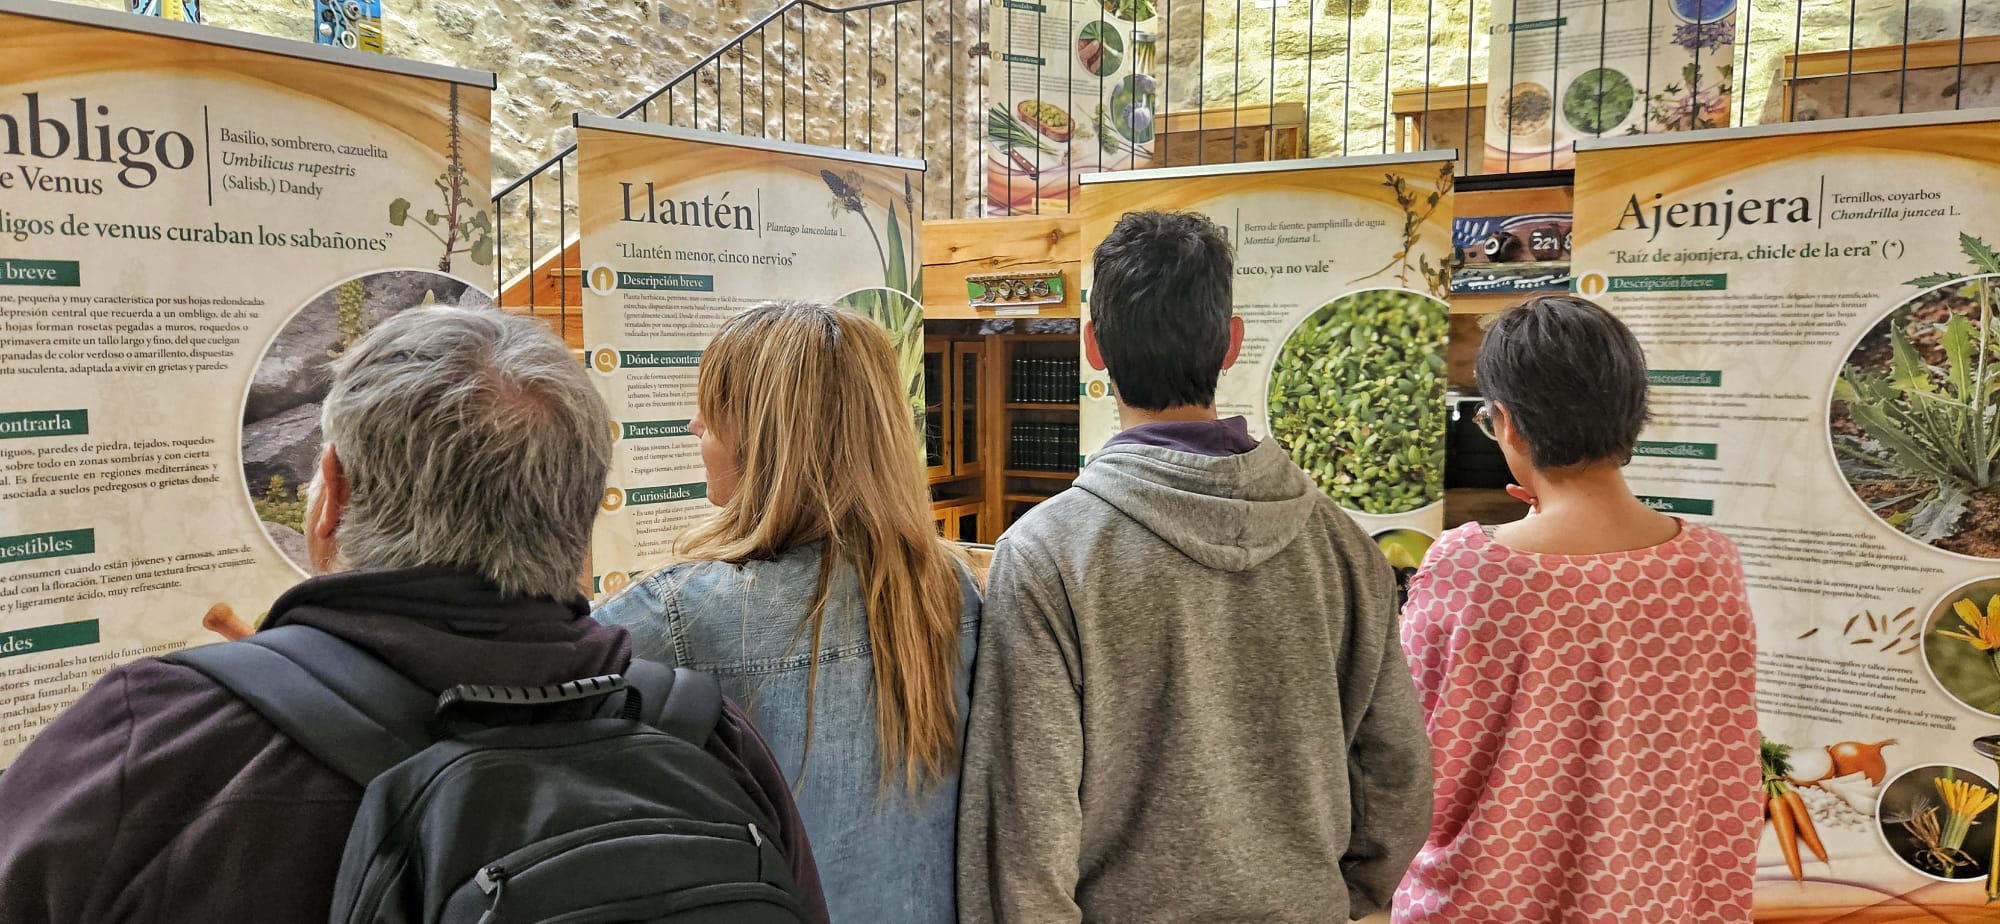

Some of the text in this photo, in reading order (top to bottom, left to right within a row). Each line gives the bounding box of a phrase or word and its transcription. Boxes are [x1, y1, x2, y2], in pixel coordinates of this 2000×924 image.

[221, 128, 389, 159] Basilio, sombrero, cazuelita
[222, 151, 357, 178] Umbilicus rupestris
[18, 165, 104, 196] Venus
[222, 174, 324, 200] (Salisb.) Dandy
[1832, 189, 1941, 205] Ternillos, coyarbos
[619, 182, 755, 232] Llantén
[1831, 205, 1961, 222] Chondrilla juncea L.
[1613, 189, 1813, 243] Ajenjera
[60, 213, 90, 237] de
[94, 222, 162, 241] venus
[167, 222, 254, 244] curaban
[258, 225, 287, 247] los
[290, 228, 393, 252] sabañones”
[766, 222, 800, 237] Plantago
[801, 224, 838, 238] lanceolata
[1244, 217, 1386, 233] Berro de fuente, pamplinilla de agua
[1244, 236, 1275, 246] Montia
[1275, 235, 1311, 247] fontana
[616, 243, 797, 267] “Llantén menor, cinco nervios”
[1609, 249, 1649, 264] “Raíz
[1653, 248, 1670, 262] de
[1674, 247, 1744, 266] ajonjera,
[1747, 244, 1797, 261] chicle
[1800, 243, 1821, 258] de
[1825, 242, 1844, 257] la
[1844, 240, 1878, 257] era”
[6, 261, 57, 281] breve
[1236, 264, 1268, 277] cuco,
[1270, 265, 1284, 278] ya
[1286, 264, 1302, 274] no
[623, 274, 703, 290] Descripción breve
[1613, 277, 1714, 292] Descripción breve
[18, 294, 60, 305] pequeña
[62, 297, 69, 306] y
[70, 297, 94, 307] muy
[94, 295, 154, 305] característica
[156, 298, 171, 307] por
[173, 297, 187, 305] sus
[189, 296, 211, 307] hojas
[213, 297, 265, 306] redondeadas
[52, 307, 87, 318] central
[90, 310, 109, 320] que
[111, 308, 153, 318] recuerda
[179, 309, 219, 321] ombligo,
[221, 310, 232, 319] de
[0, 336, 240, 348] primavera emite un tallo largo y fino, del que cuelgan
[45, 350, 57, 359] de
[59, 350, 85, 359] color
[87, 350, 124, 359] verdoso
[134, 349, 189, 359] amarillento,
[190, 349, 235, 362] dispuestas
[627, 353, 659, 365] Dónde
[18, 364, 68, 375] suculenta,
[70, 363, 113, 376] adaptada
[123, 363, 144, 373] vivir
[145, 364, 156, 372] en
[159, 364, 188, 375] grietas
[189, 365, 195, 374] y
[196, 362, 229, 374] paredes
[630, 425, 659, 437] Partes
[1, 436, 216, 460] tiguos, paredes de piedra, tejados, roquedos
[1639, 444, 1705, 457] comestibles
[3, 487, 47, 501] asociada
[59, 484, 90, 495] suelos
[93, 481, 148, 496] pedregosos
[159, 477, 189, 490] grietas
[191, 473, 221, 485] donde
[632, 487, 691, 503] Curiosidades
[21, 585, 39, 595] con
[42, 583, 50, 591] la
[53, 578, 98, 591] floración.
[100, 574, 133, 585] Tienen
[135, 571, 152, 580] una
[154, 567, 184, 577] textura
[186, 564, 210, 574] fresca
[0, 636, 33, 655] des
[8, 640, 188, 677] tradicionales ha tenido funciones muy
